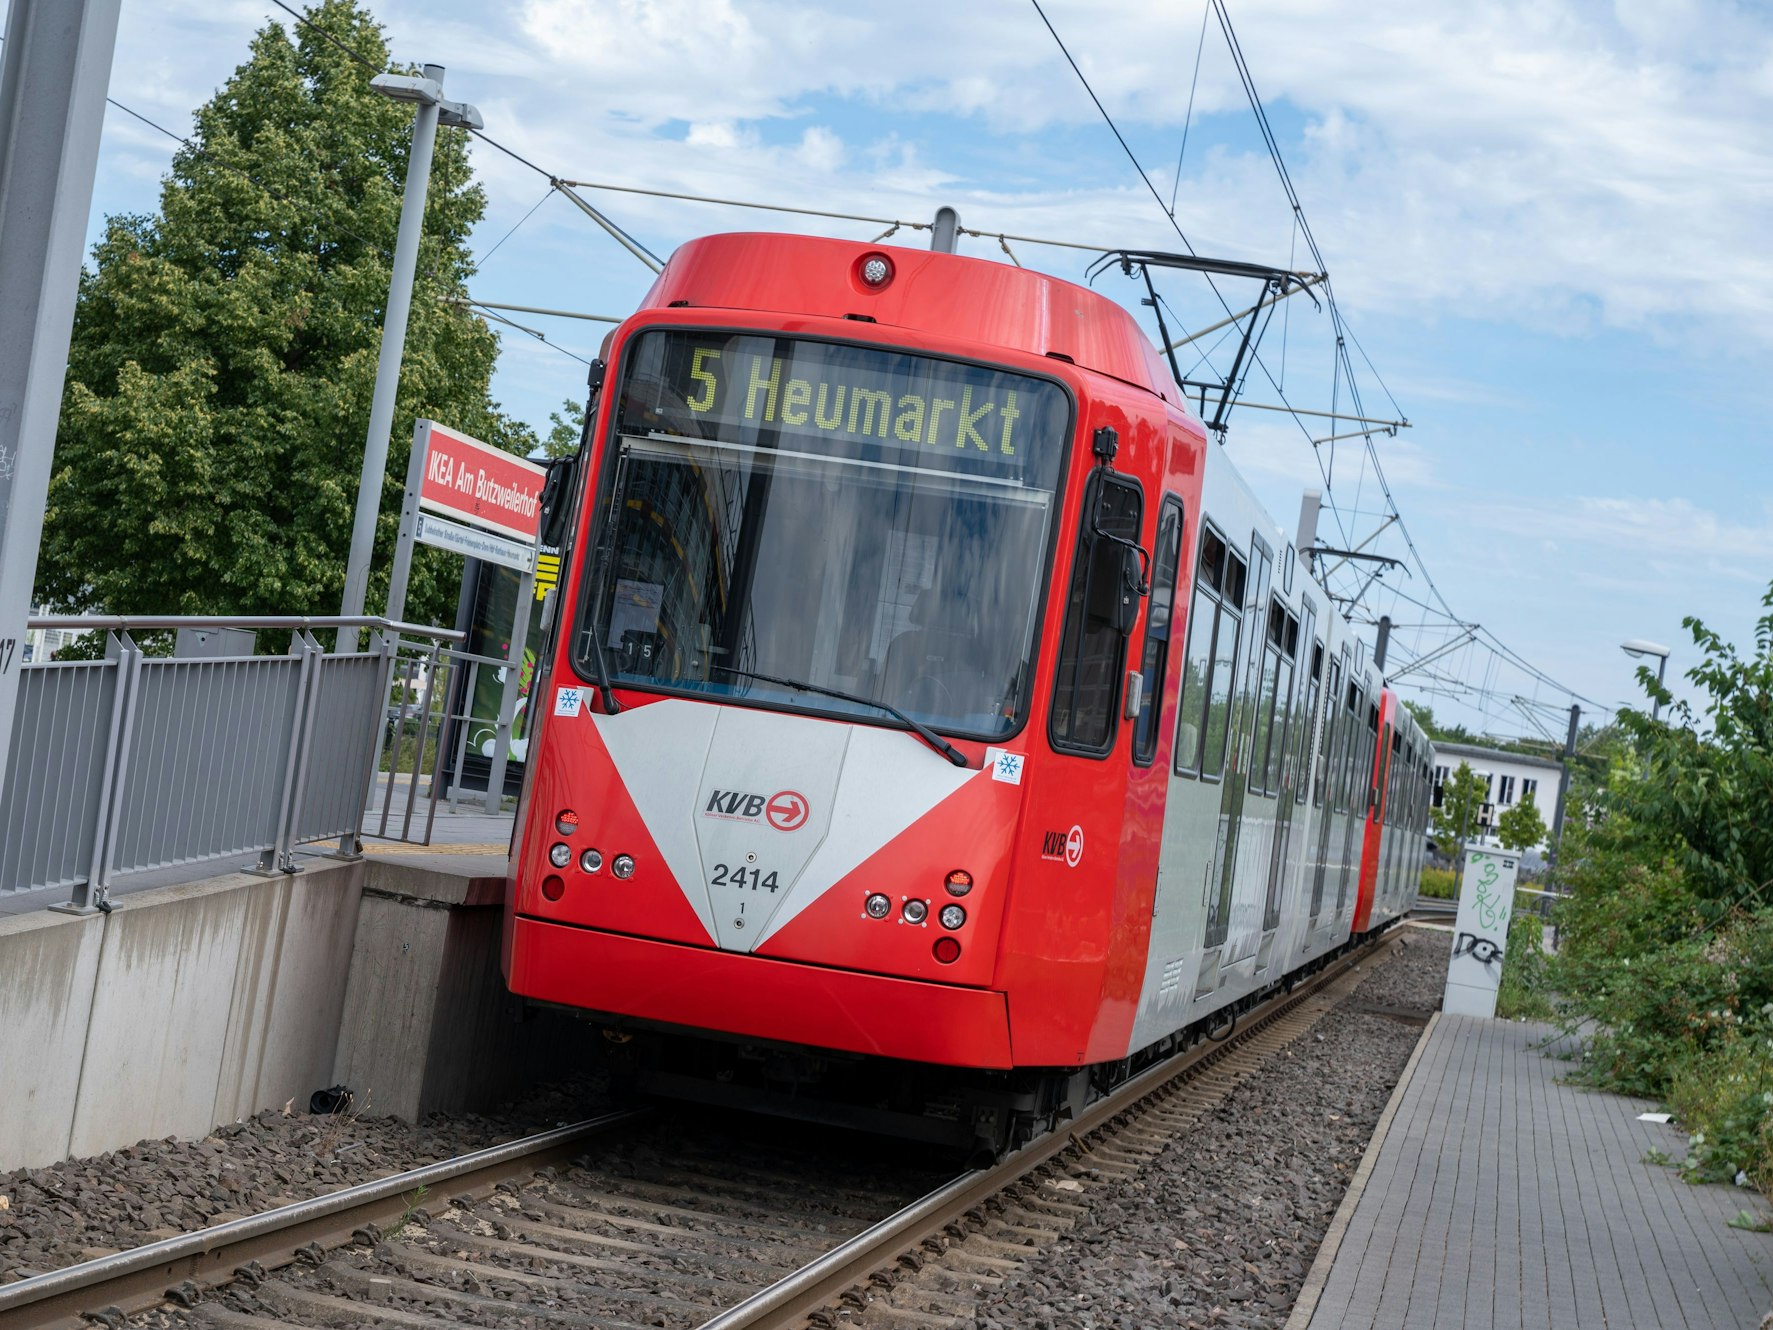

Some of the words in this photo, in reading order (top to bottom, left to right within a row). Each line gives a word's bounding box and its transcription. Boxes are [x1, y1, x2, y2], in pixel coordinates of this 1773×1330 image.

[687, 348, 720, 413] 5
[744, 355, 1020, 456] Heumarkt
[428, 450, 453, 488] IKEA
[455, 462, 474, 496] Am
[475, 469, 540, 518] Butzweilerhof
[706, 790, 766, 817] KVB
[1477, 804, 1493, 826] H
[1042, 831, 1067, 856] KVB
[711, 863, 779, 893] 2414
[740, 902, 745, 914] 1
